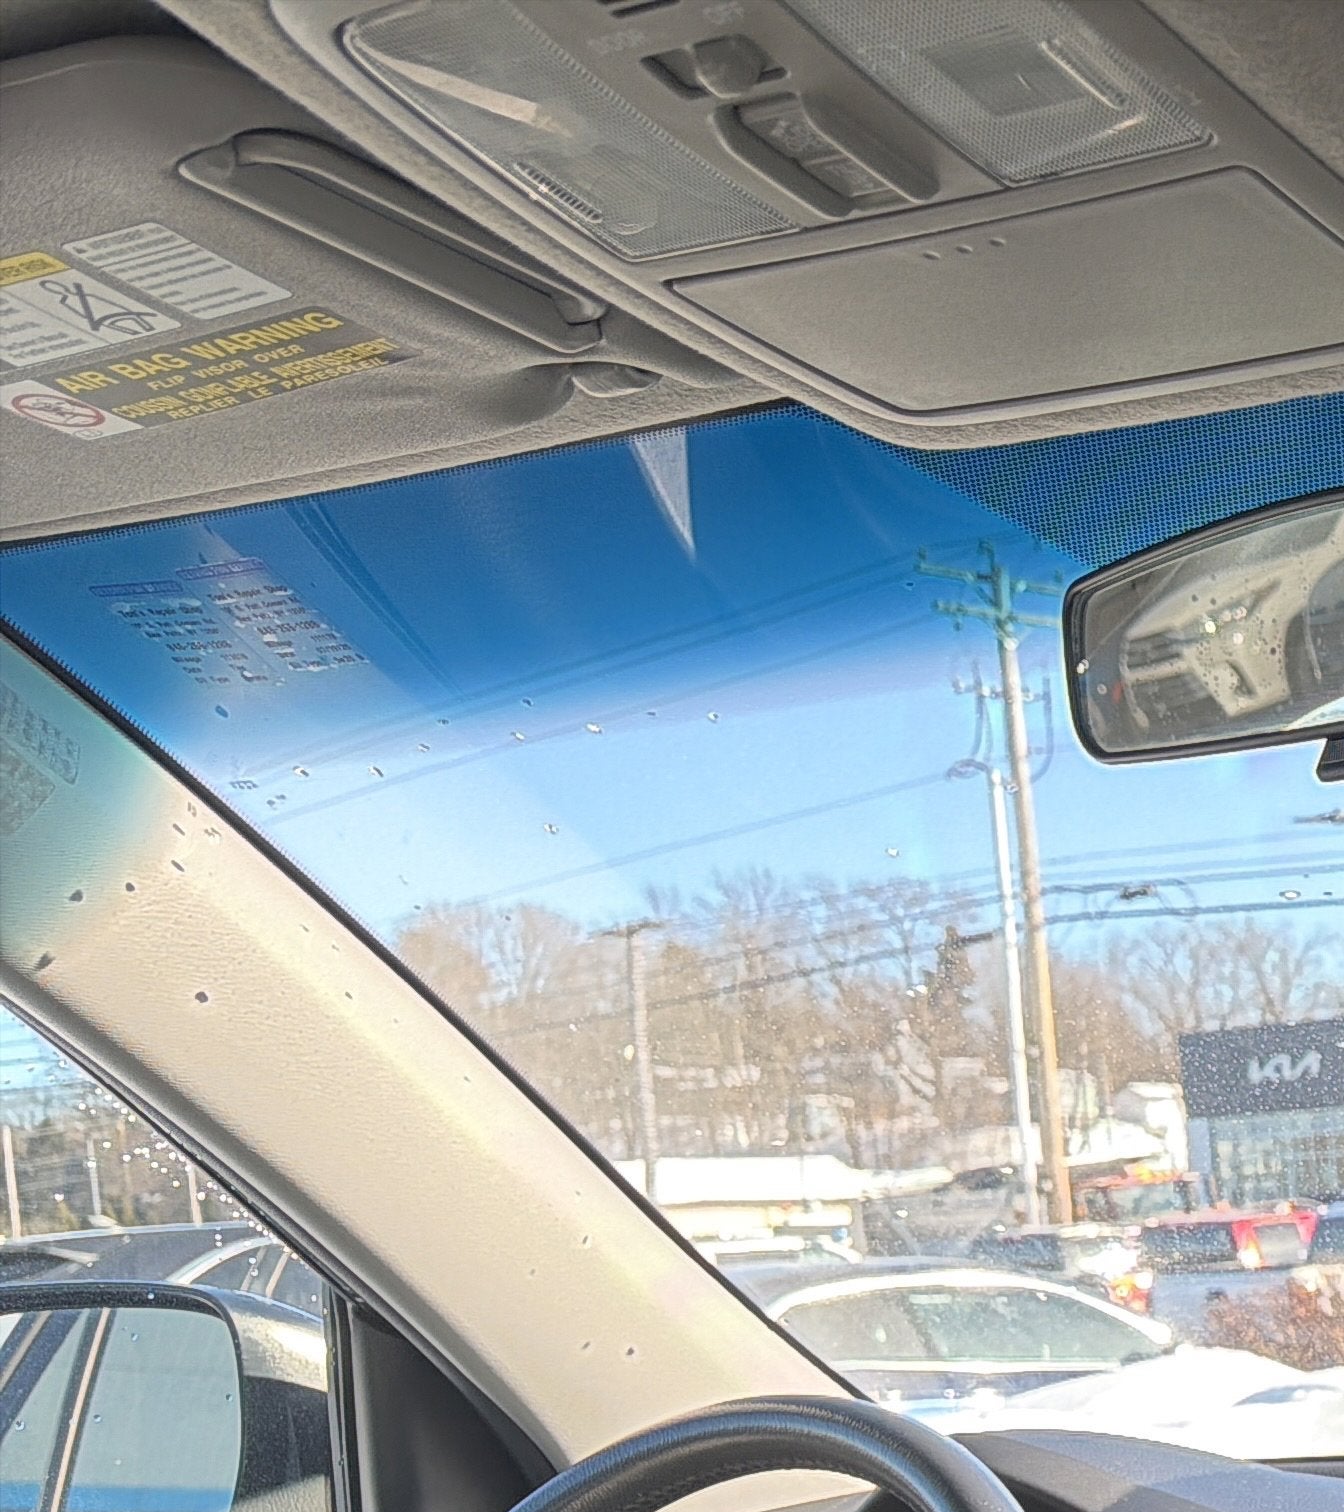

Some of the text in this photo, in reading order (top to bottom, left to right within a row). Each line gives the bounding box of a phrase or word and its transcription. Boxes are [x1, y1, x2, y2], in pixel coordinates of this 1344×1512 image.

[55, 311, 345, 395] AIR BAG WARNING
[147, 343, 305, 392] FLIP VISOR OVER
[168, 397, 241, 421] REPLIER
[250, 386, 276, 399] LE
